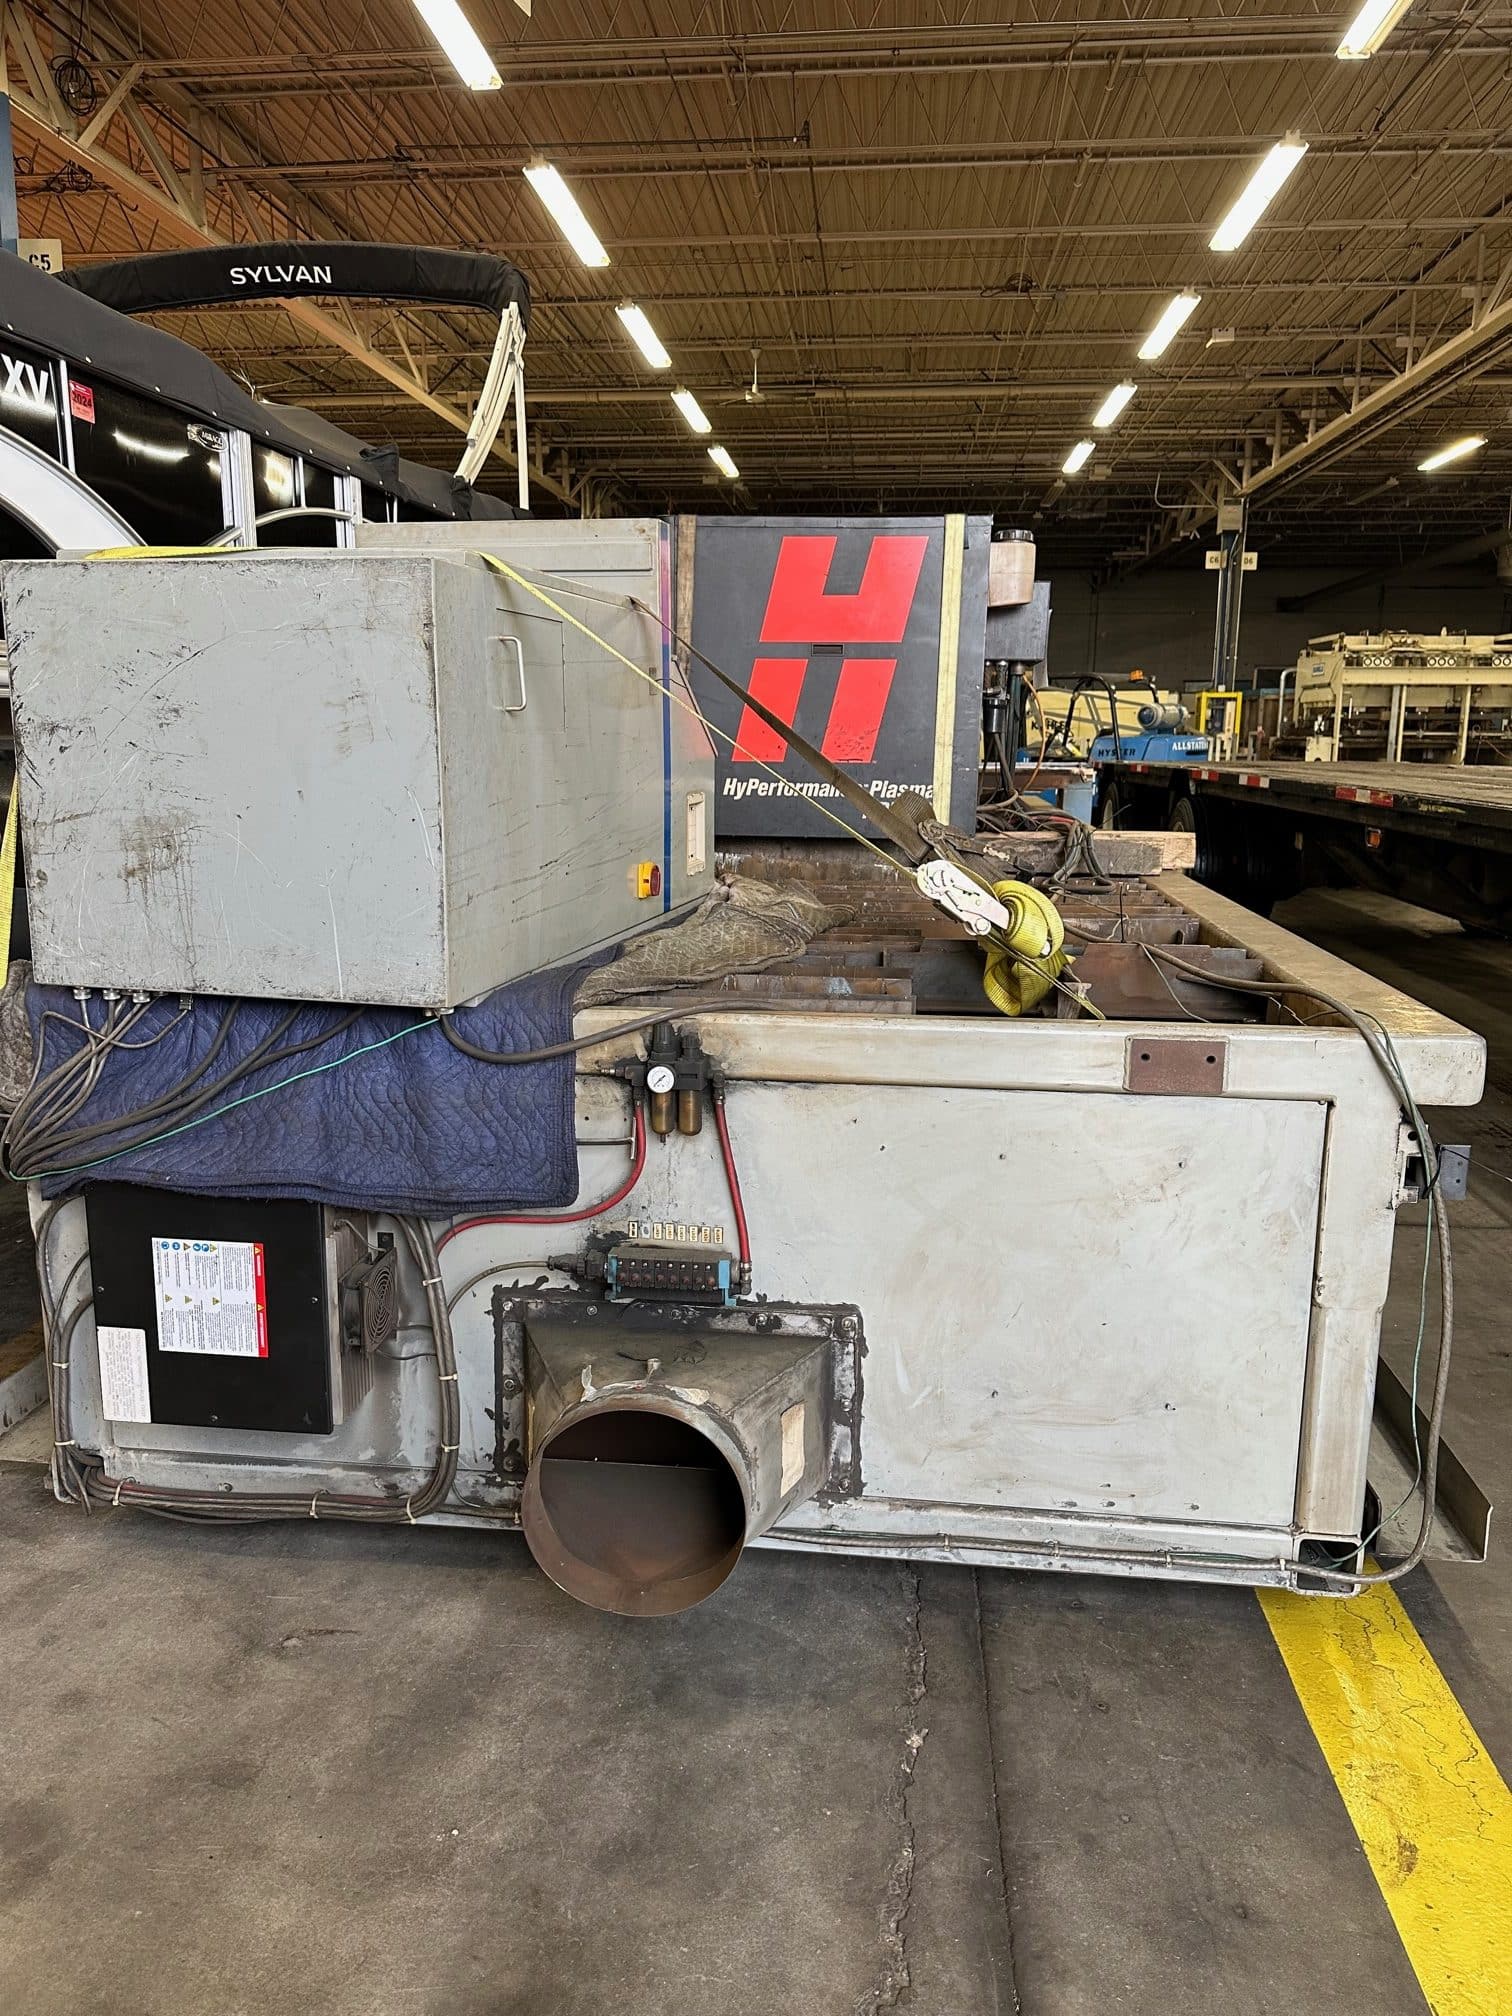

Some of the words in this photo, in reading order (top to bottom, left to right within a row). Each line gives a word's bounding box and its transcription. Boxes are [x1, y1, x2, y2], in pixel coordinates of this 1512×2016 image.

[28, 253, 52, 272] C5
[229, 264, 333, 285] SYLVAN
[71, 391, 93, 408] 2024
[722, 777, 860, 801] HyPerforman
